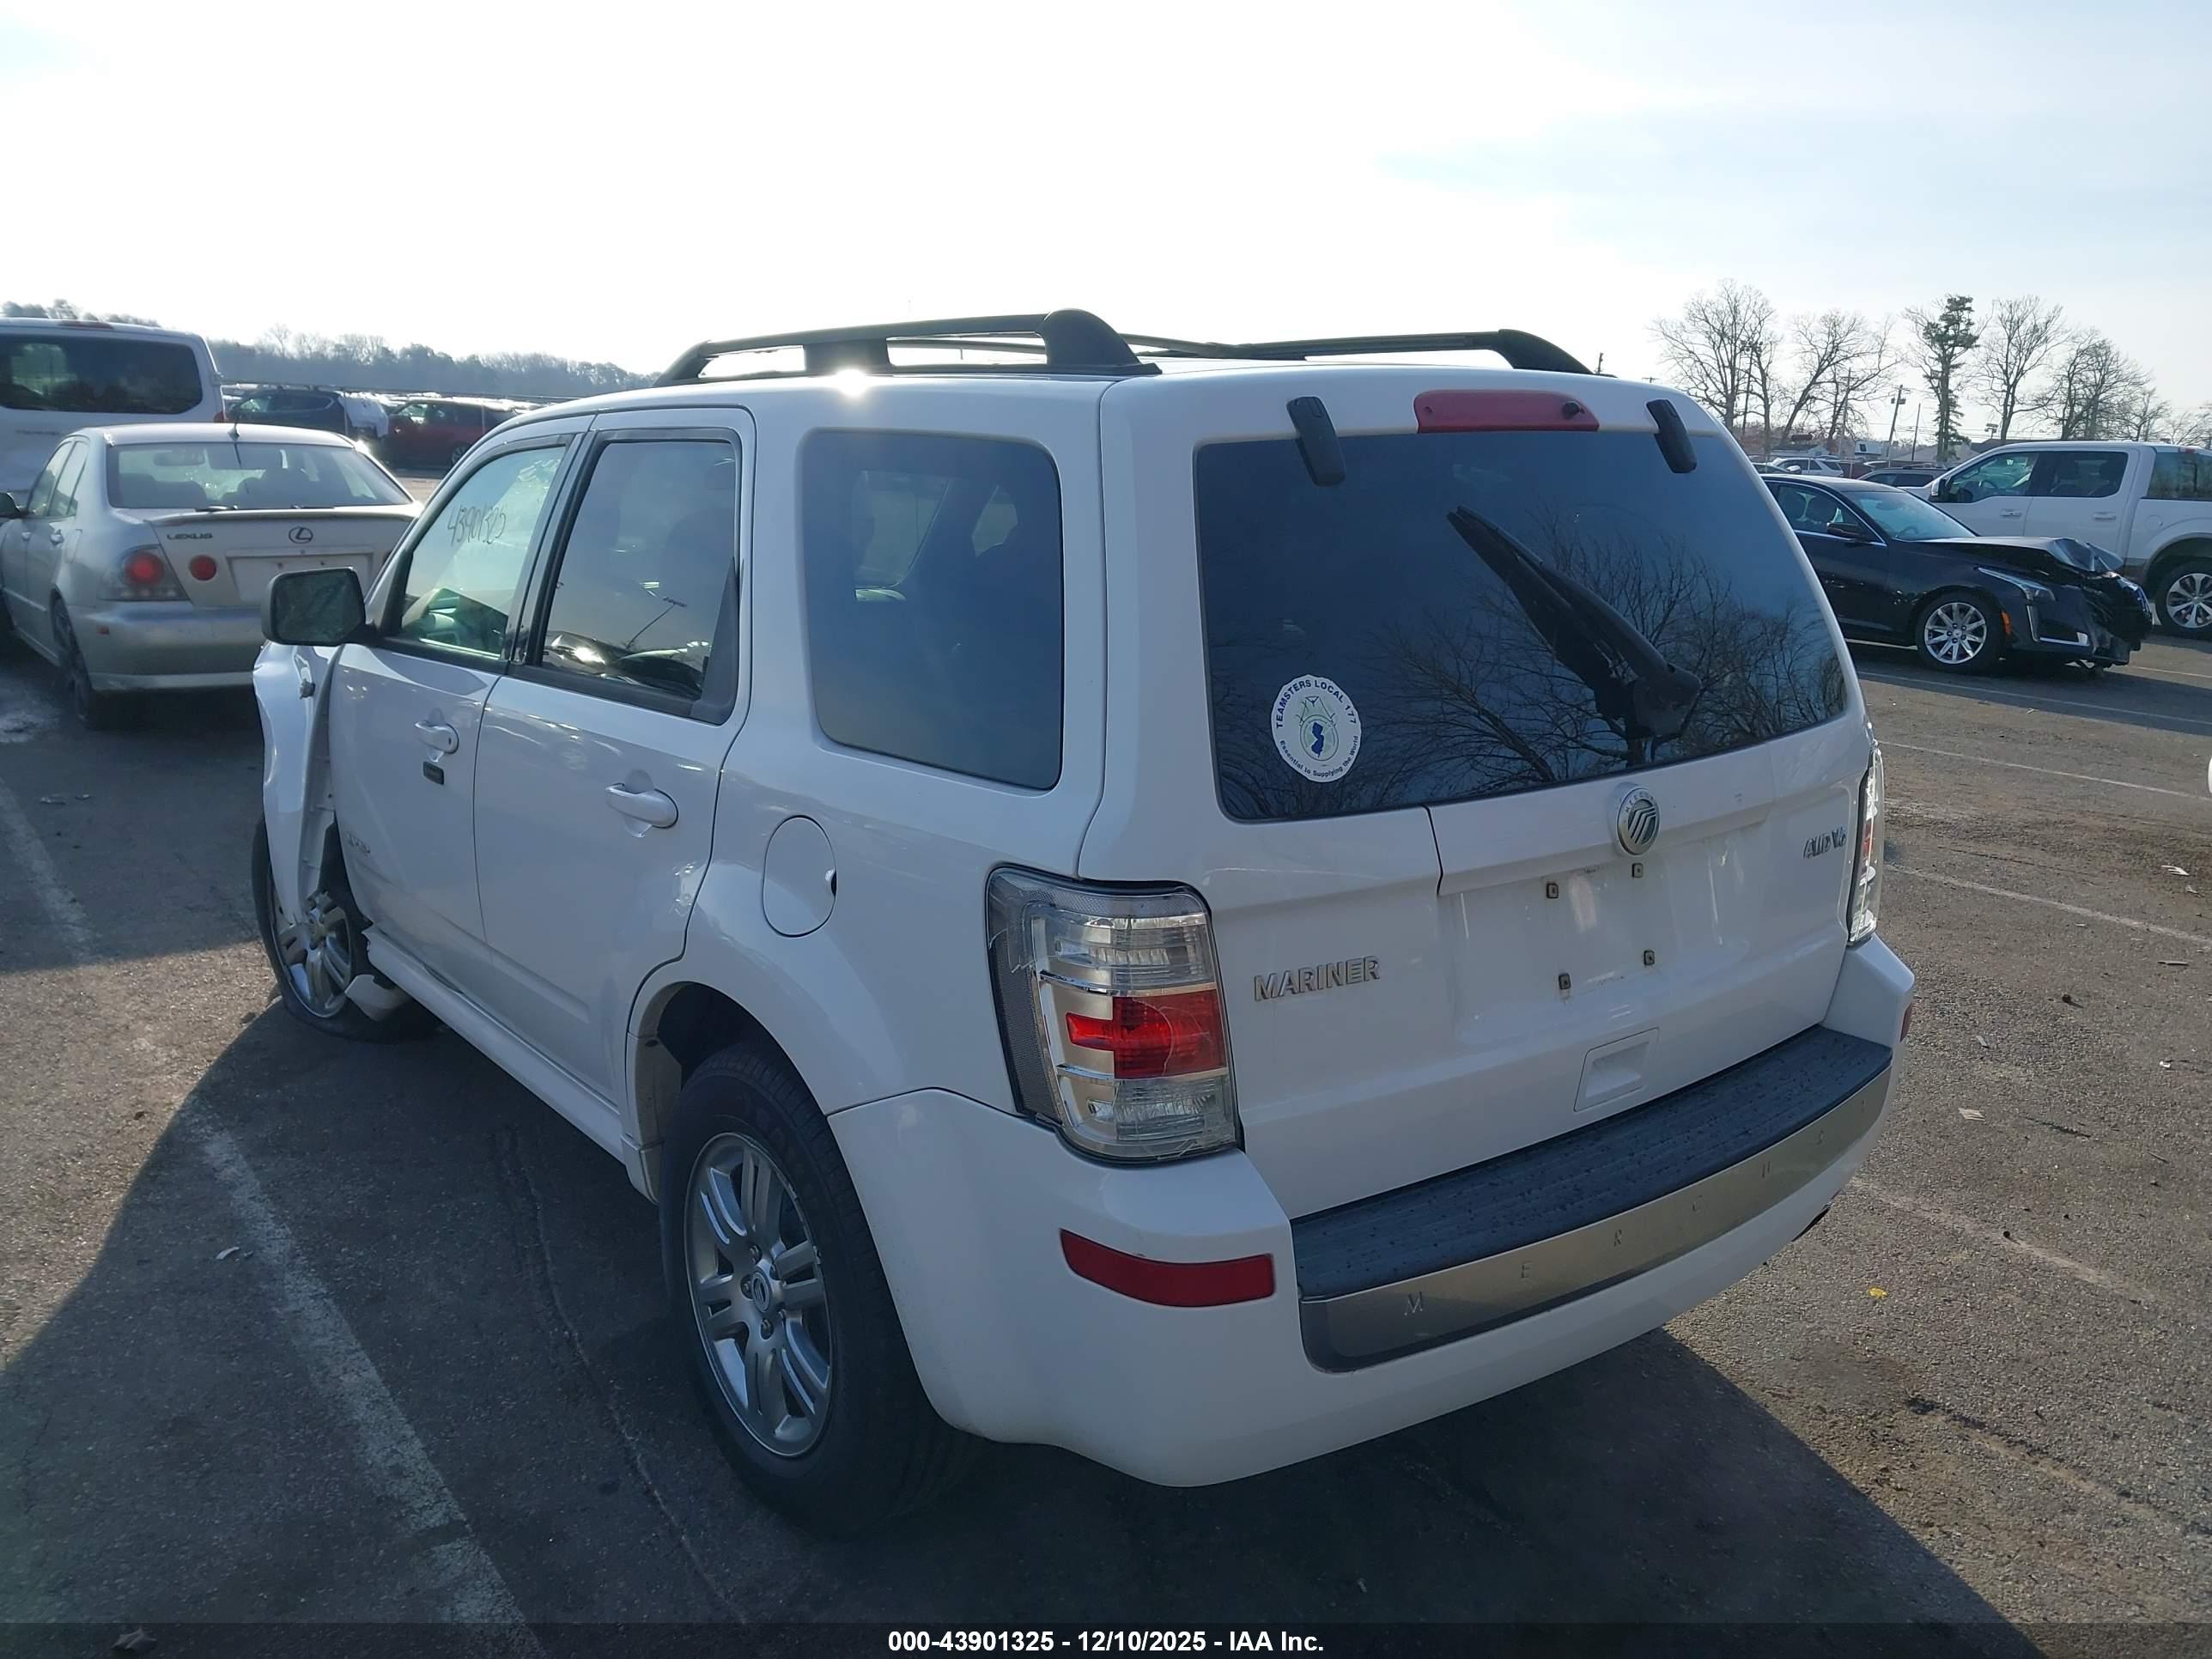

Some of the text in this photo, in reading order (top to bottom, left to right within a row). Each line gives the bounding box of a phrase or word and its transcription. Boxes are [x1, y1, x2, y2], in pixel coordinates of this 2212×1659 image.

[1276, 679, 1357, 728] TEAMSTERS LOCAL 177
[1279, 740, 1304, 770] Essential
[1313, 766, 1343, 778] Supplying
[1342, 757, 1352, 767] the
[1349, 735, 1358, 756] World
[1254, 956, 1380, 1002] MARINER
